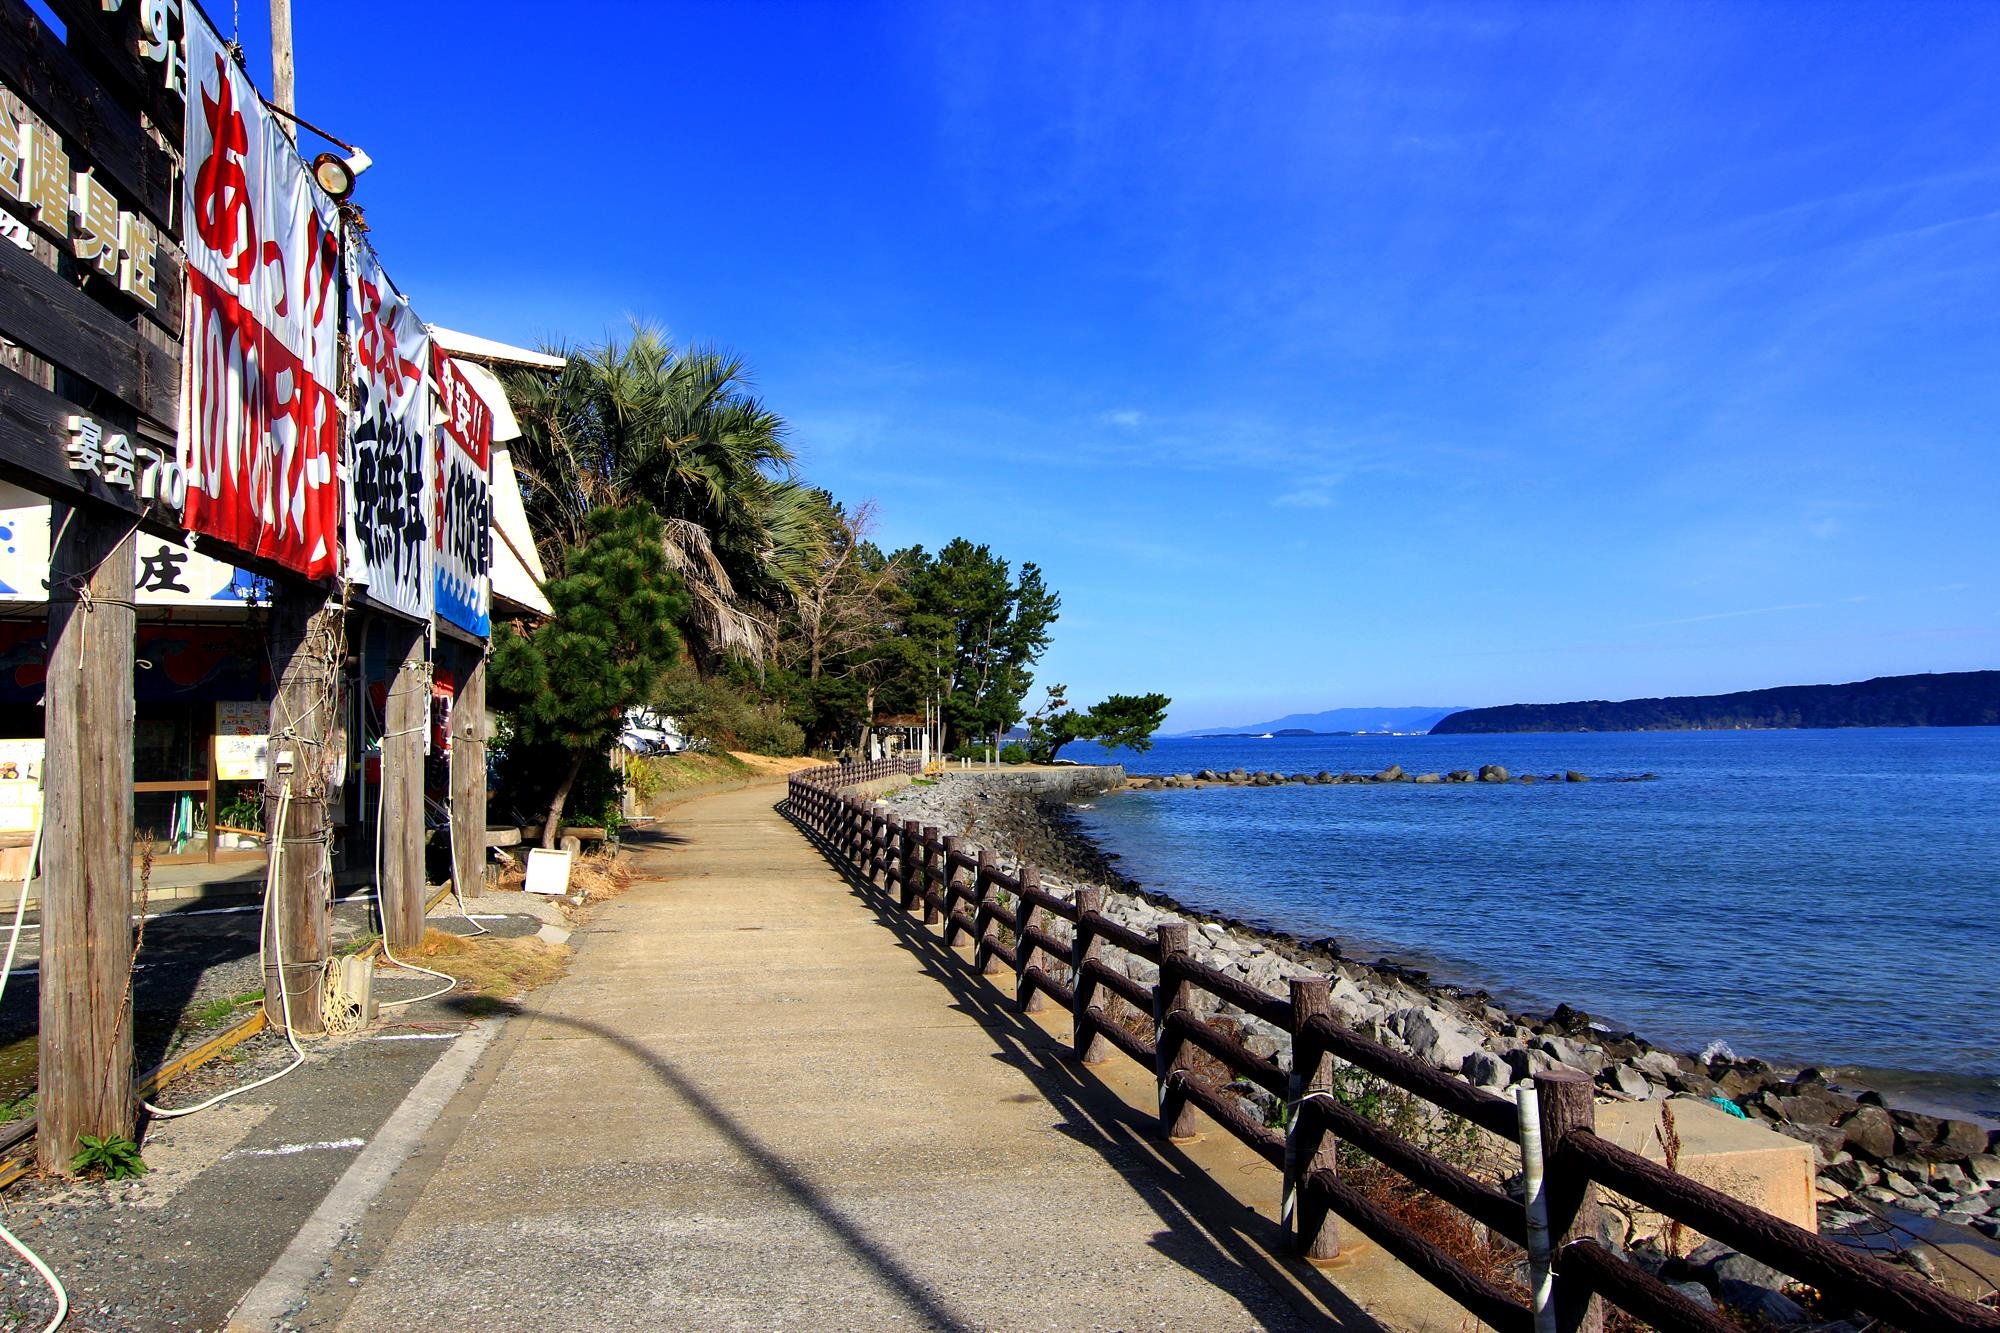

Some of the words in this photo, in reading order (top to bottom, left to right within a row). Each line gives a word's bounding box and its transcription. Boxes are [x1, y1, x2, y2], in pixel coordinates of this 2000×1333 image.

[358, 274, 421, 408] 日本一
[350, 377, 427, 605] 海鮮丼
